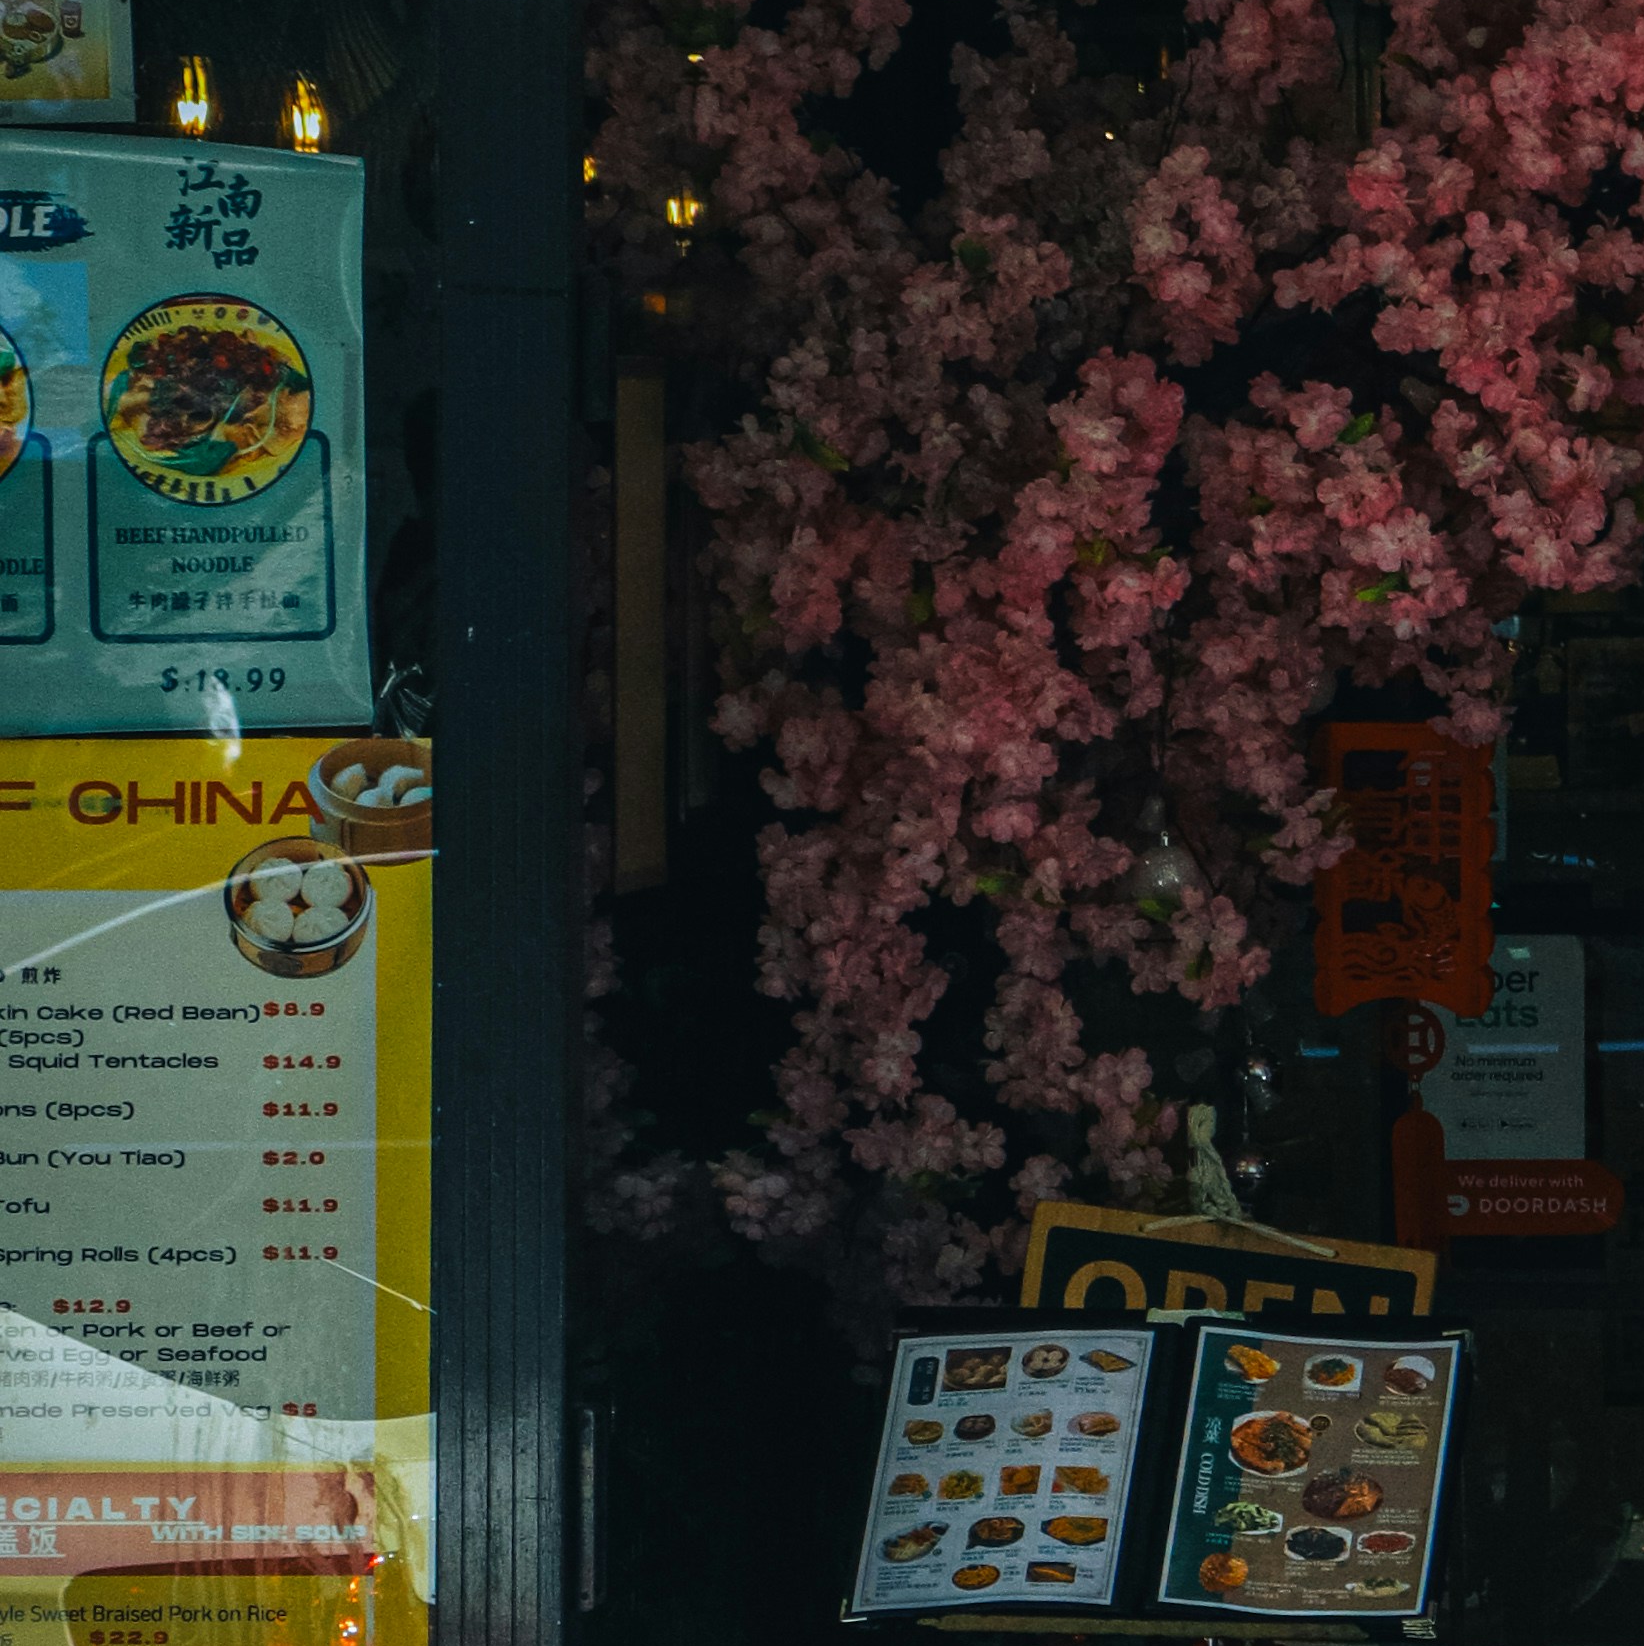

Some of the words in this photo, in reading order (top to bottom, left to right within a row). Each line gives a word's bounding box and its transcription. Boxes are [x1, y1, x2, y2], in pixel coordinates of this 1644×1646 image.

[114, 526, 165, 545] BEEF
[172, 525, 309, 544] HANDPULLED
[171, 556, 254, 574] NOODLE
[68, 779, 326, 826] CHINA
[37, 1004, 104, 1020] Cake
[113, 1004, 173, 1023] (Red
[182, 1004, 261, 1023] Bean)
[263, 1002, 325, 1017] $8.9
[0, 1029, 84, 1048] (5pcs)
[8, 1053, 79, 1072] Squid
[91, 1054, 219, 1069] Tentacles
[263, 1055, 341, 1070] $14.9
[0, 1103, 37, 1118] ns
[46, 1101, 135, 1120] (8pcs)
[263, 1102, 338, 1117] $11.9
[48, 1150, 112, 1169] (You
[120, 1150, 185, 1169] Tiao)
[263, 1151, 325, 1166] $2.0
[1458, 1175, 1485, 1188] We
[1488, 1174, 1545, 1188] deliver
[1548, 1174, 1584, 1188] with
[263, 1198, 338, 1213] $11.9
[1478, 1197, 1608, 1215] DOORDASH
[81, 1247, 139, 1262] Rolls
[147, 1245, 237, 1266] (4pcs)
[263, 1245, 338, 1261] $11.9
[53, 1299, 131, 1314] $12.9
[46, 1325, 74, 1338] or
[82, 1321, 145, 1338] Pork
[155, 1325, 183, 1338] or
[192, 1321, 253, 1338] Beef
[263, 1325, 292, 1338] or
[63, 1347, 110, 1367] Egg
[119, 1349, 147, 1363] or
[157, 1346, 268, 1363] Seafood
[71, 1402, 212, 1420] Preserved
[221, 1402, 272, 1422] Veg
[282, 1402, 318, 1417] $5
[151, 1524, 223, 1542] WITH
[230, 1524, 288, 1542] SIDE
[30, 1605, 87, 1623] Sweet
[93, 1605, 163, 1623] Braised
[169, 1605, 212, 1623] Pork
[217, 1609, 242, 1623] on
[247, 1605, 287, 1623] Rice
[89, 1630, 169, 1646] $22.9
